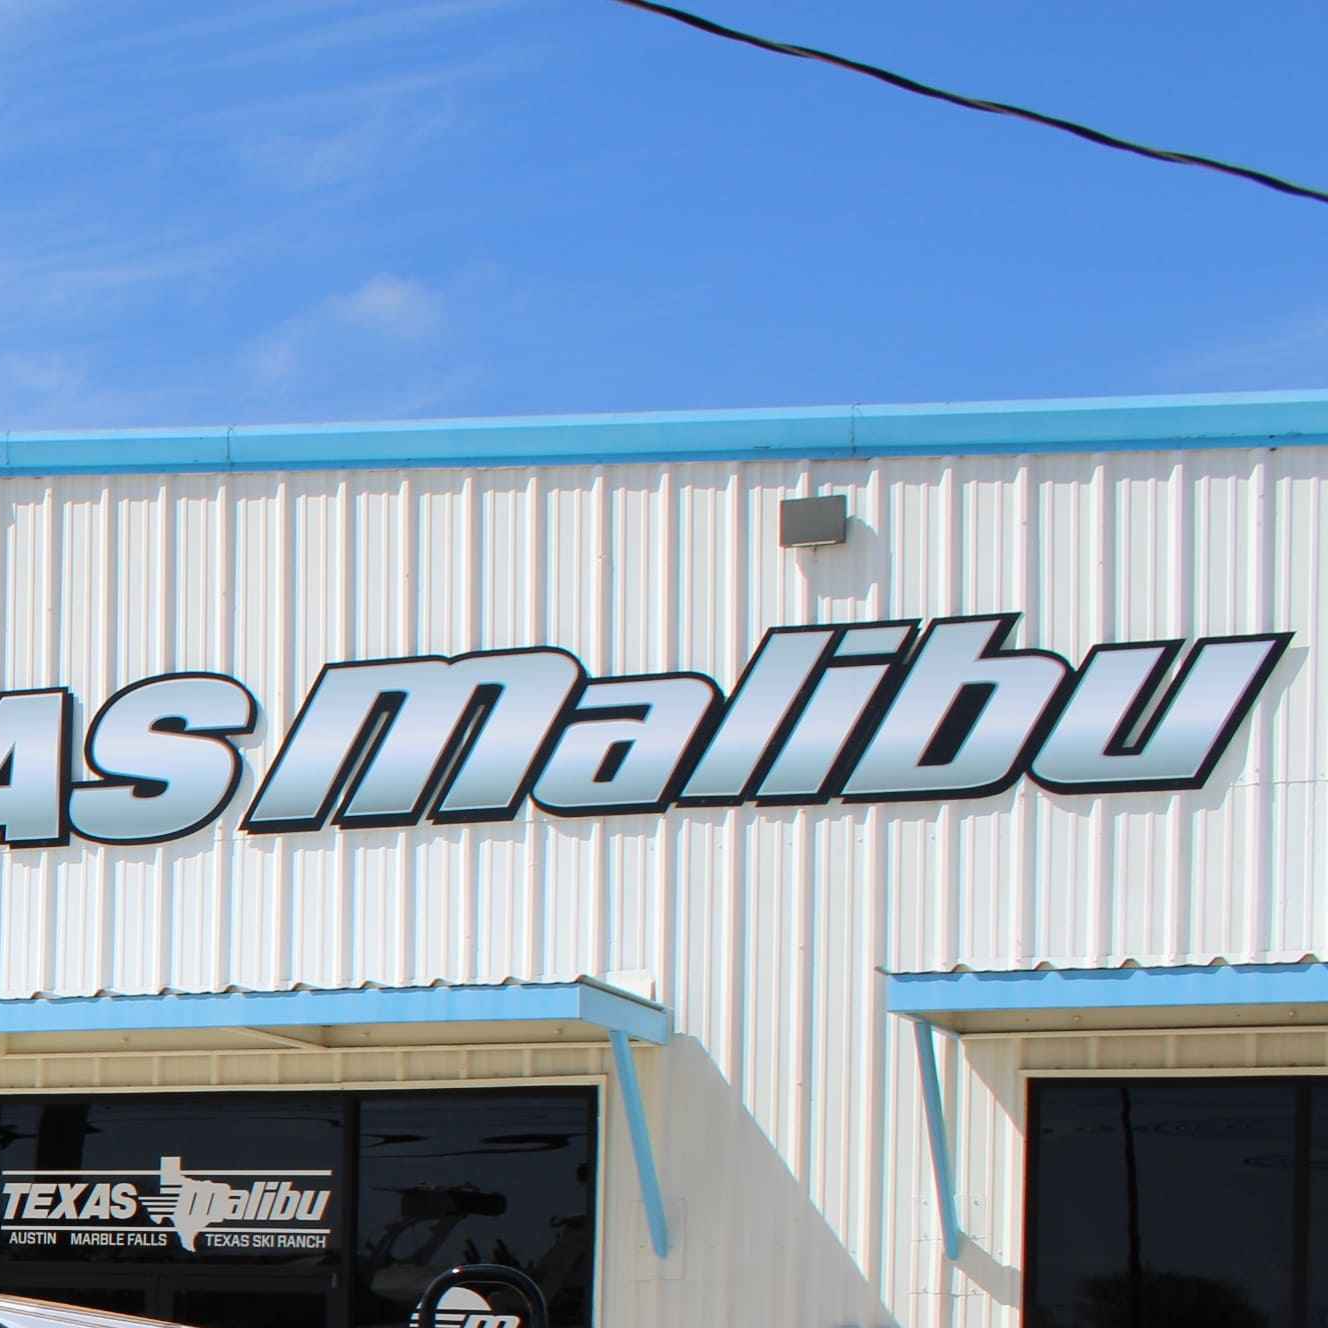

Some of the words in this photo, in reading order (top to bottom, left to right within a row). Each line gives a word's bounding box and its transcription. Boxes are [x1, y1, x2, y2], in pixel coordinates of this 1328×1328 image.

[239, 612, 1296, 834] Malibu
[2, 1182, 137, 1219] TEXAS
[178, 1181, 331, 1220] Malibu
[9, 1232, 56, 1245] AUSTIN
[70, 1233, 124, 1246] MARBLE
[127, 1234, 168, 1246] FALLS
[205, 1234, 249, 1247] TEXAS
[251, 1235, 274, 1248] SKI
[277, 1235, 326, 1248] RANCH
